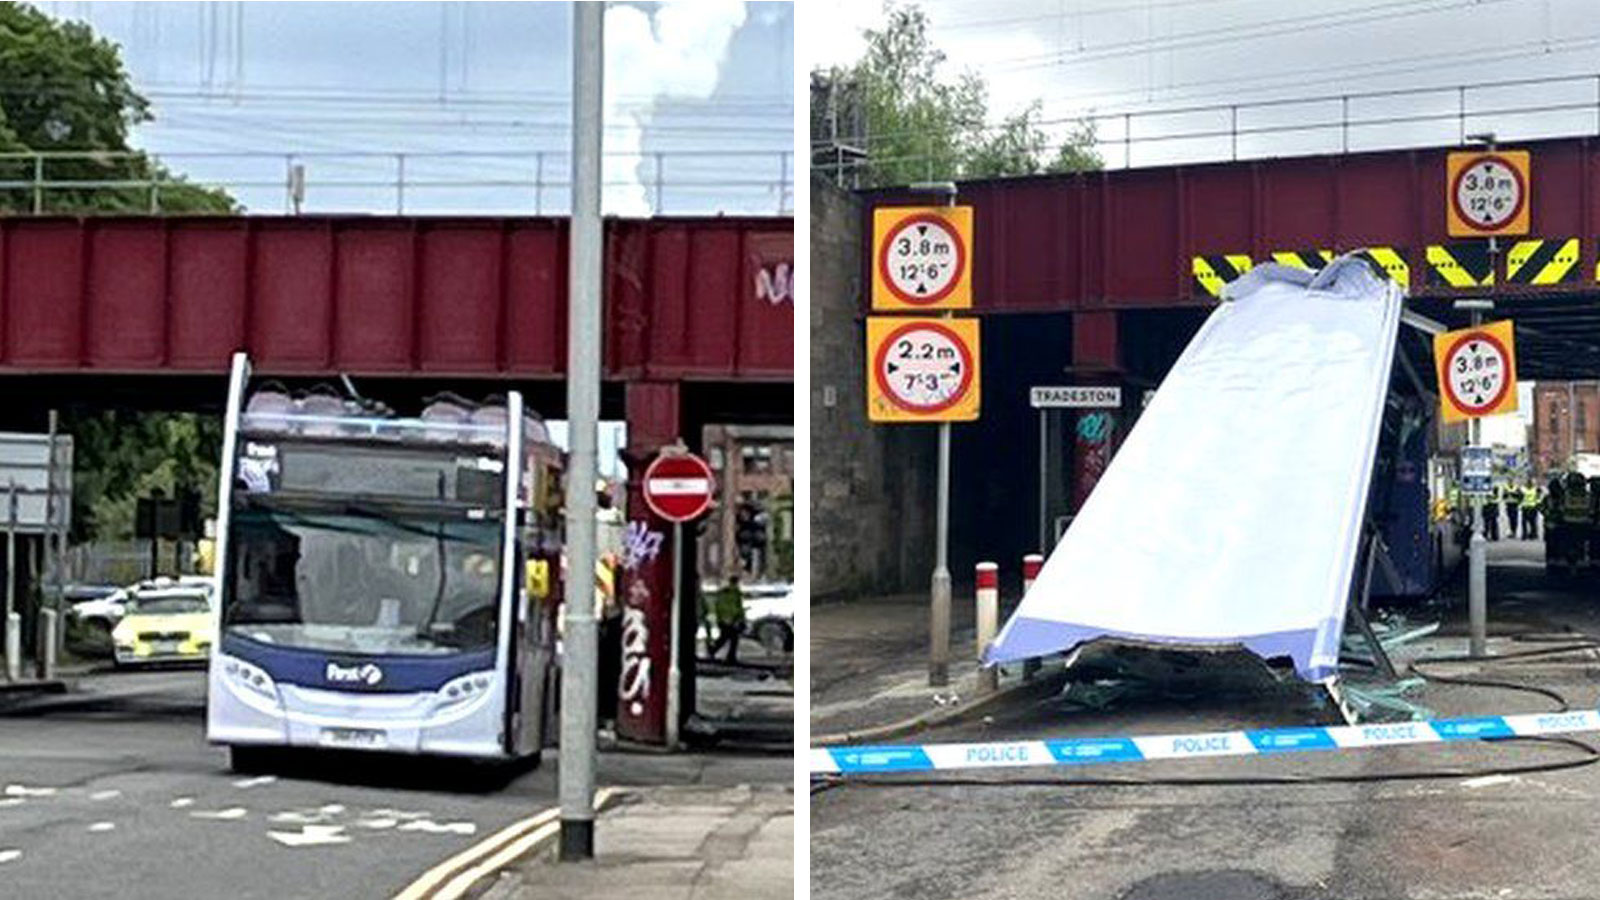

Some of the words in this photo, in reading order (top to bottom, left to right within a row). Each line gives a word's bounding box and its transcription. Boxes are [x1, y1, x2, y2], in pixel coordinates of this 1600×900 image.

[1035, 390, 1117, 402] TRADESTON
[1537, 713, 1587, 728] POLICE
[1362, 724, 1416, 740] POLICE
[1172, 737, 1231, 754] POLICE
[966, 745, 1029, 763] POLICE
